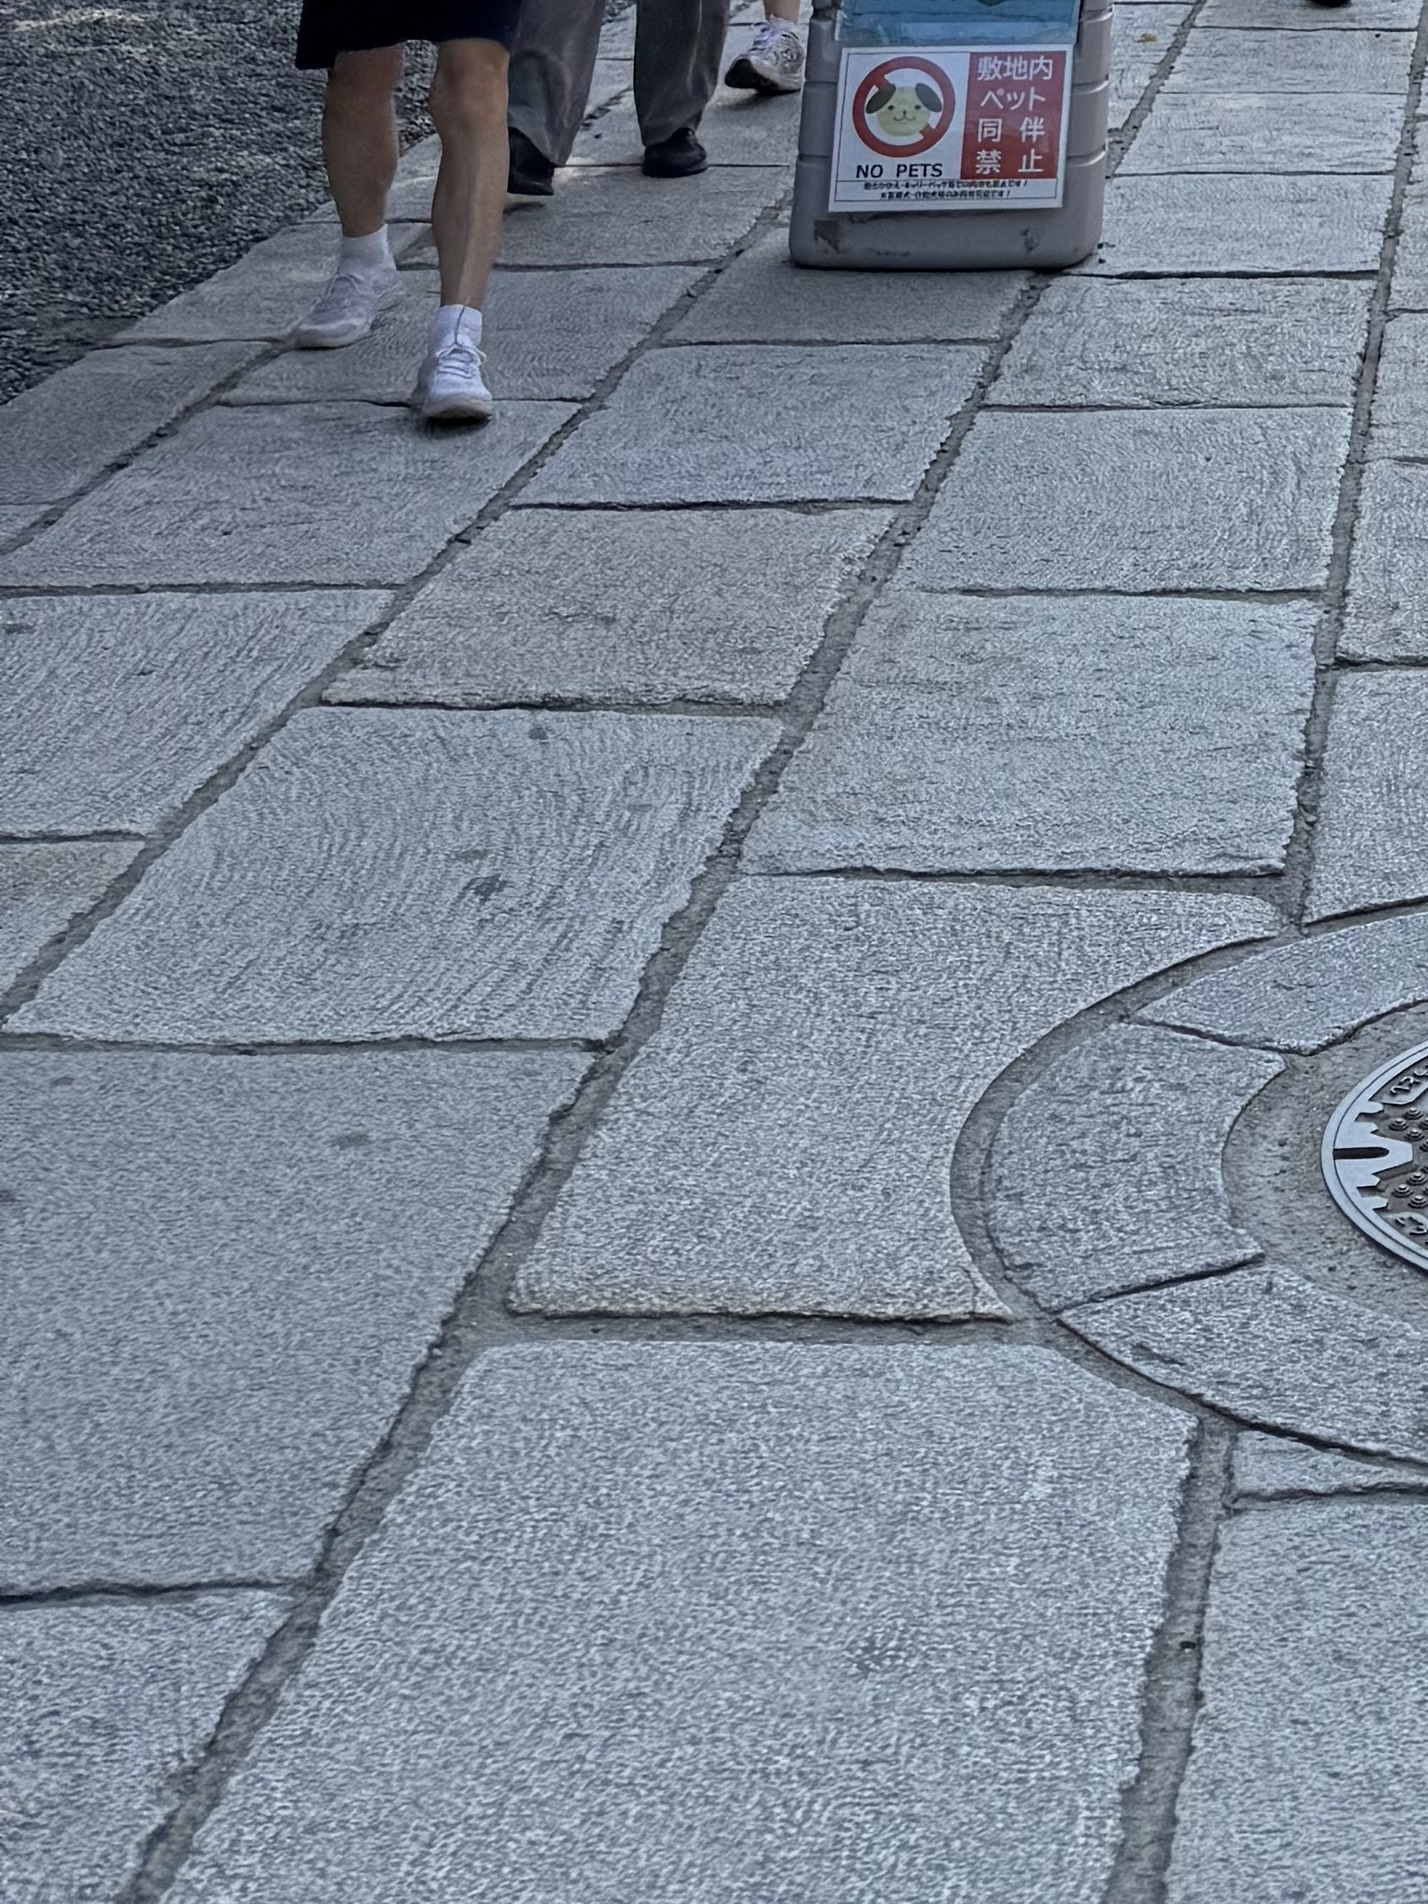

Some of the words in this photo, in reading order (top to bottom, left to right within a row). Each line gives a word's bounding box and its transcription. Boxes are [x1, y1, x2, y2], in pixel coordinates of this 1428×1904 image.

[976, 55, 1053, 81] 敷地内
[980, 87, 1046, 111] ペット
[856, 164, 883, 179] NO
[896, 163, 943, 178] PETS
